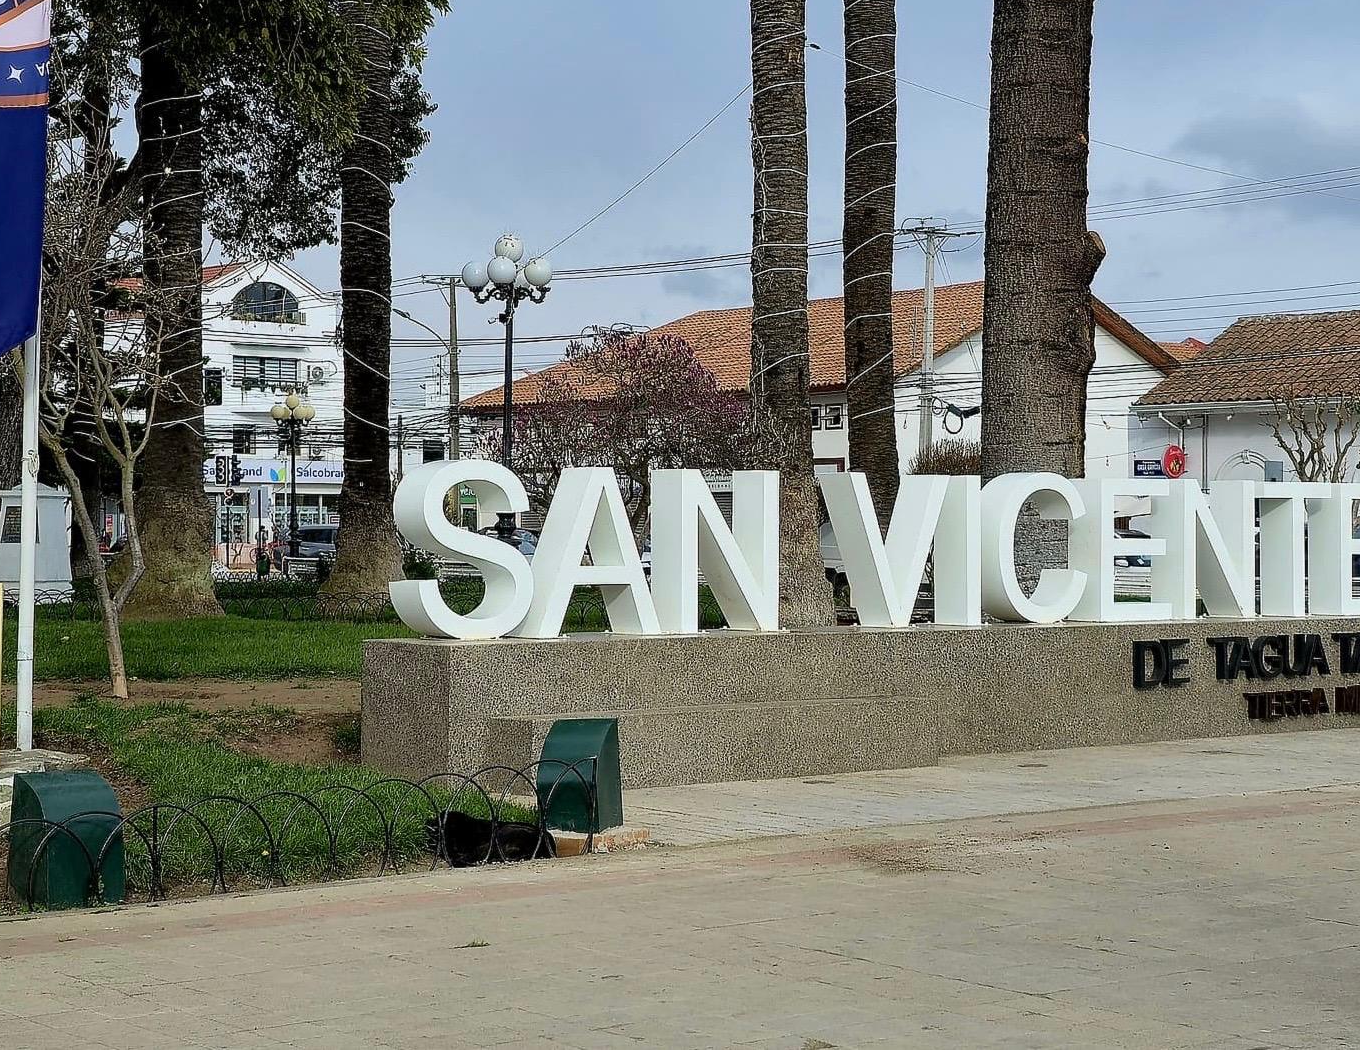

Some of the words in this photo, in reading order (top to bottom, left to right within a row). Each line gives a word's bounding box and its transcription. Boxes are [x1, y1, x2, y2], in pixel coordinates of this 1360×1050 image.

[389, 459, 780, 640] SAN
[1132, 638, 1190, 689] DE
[1206, 633, 1331, 680] TAGUA
[1243, 688, 1330, 719] TIERRA
